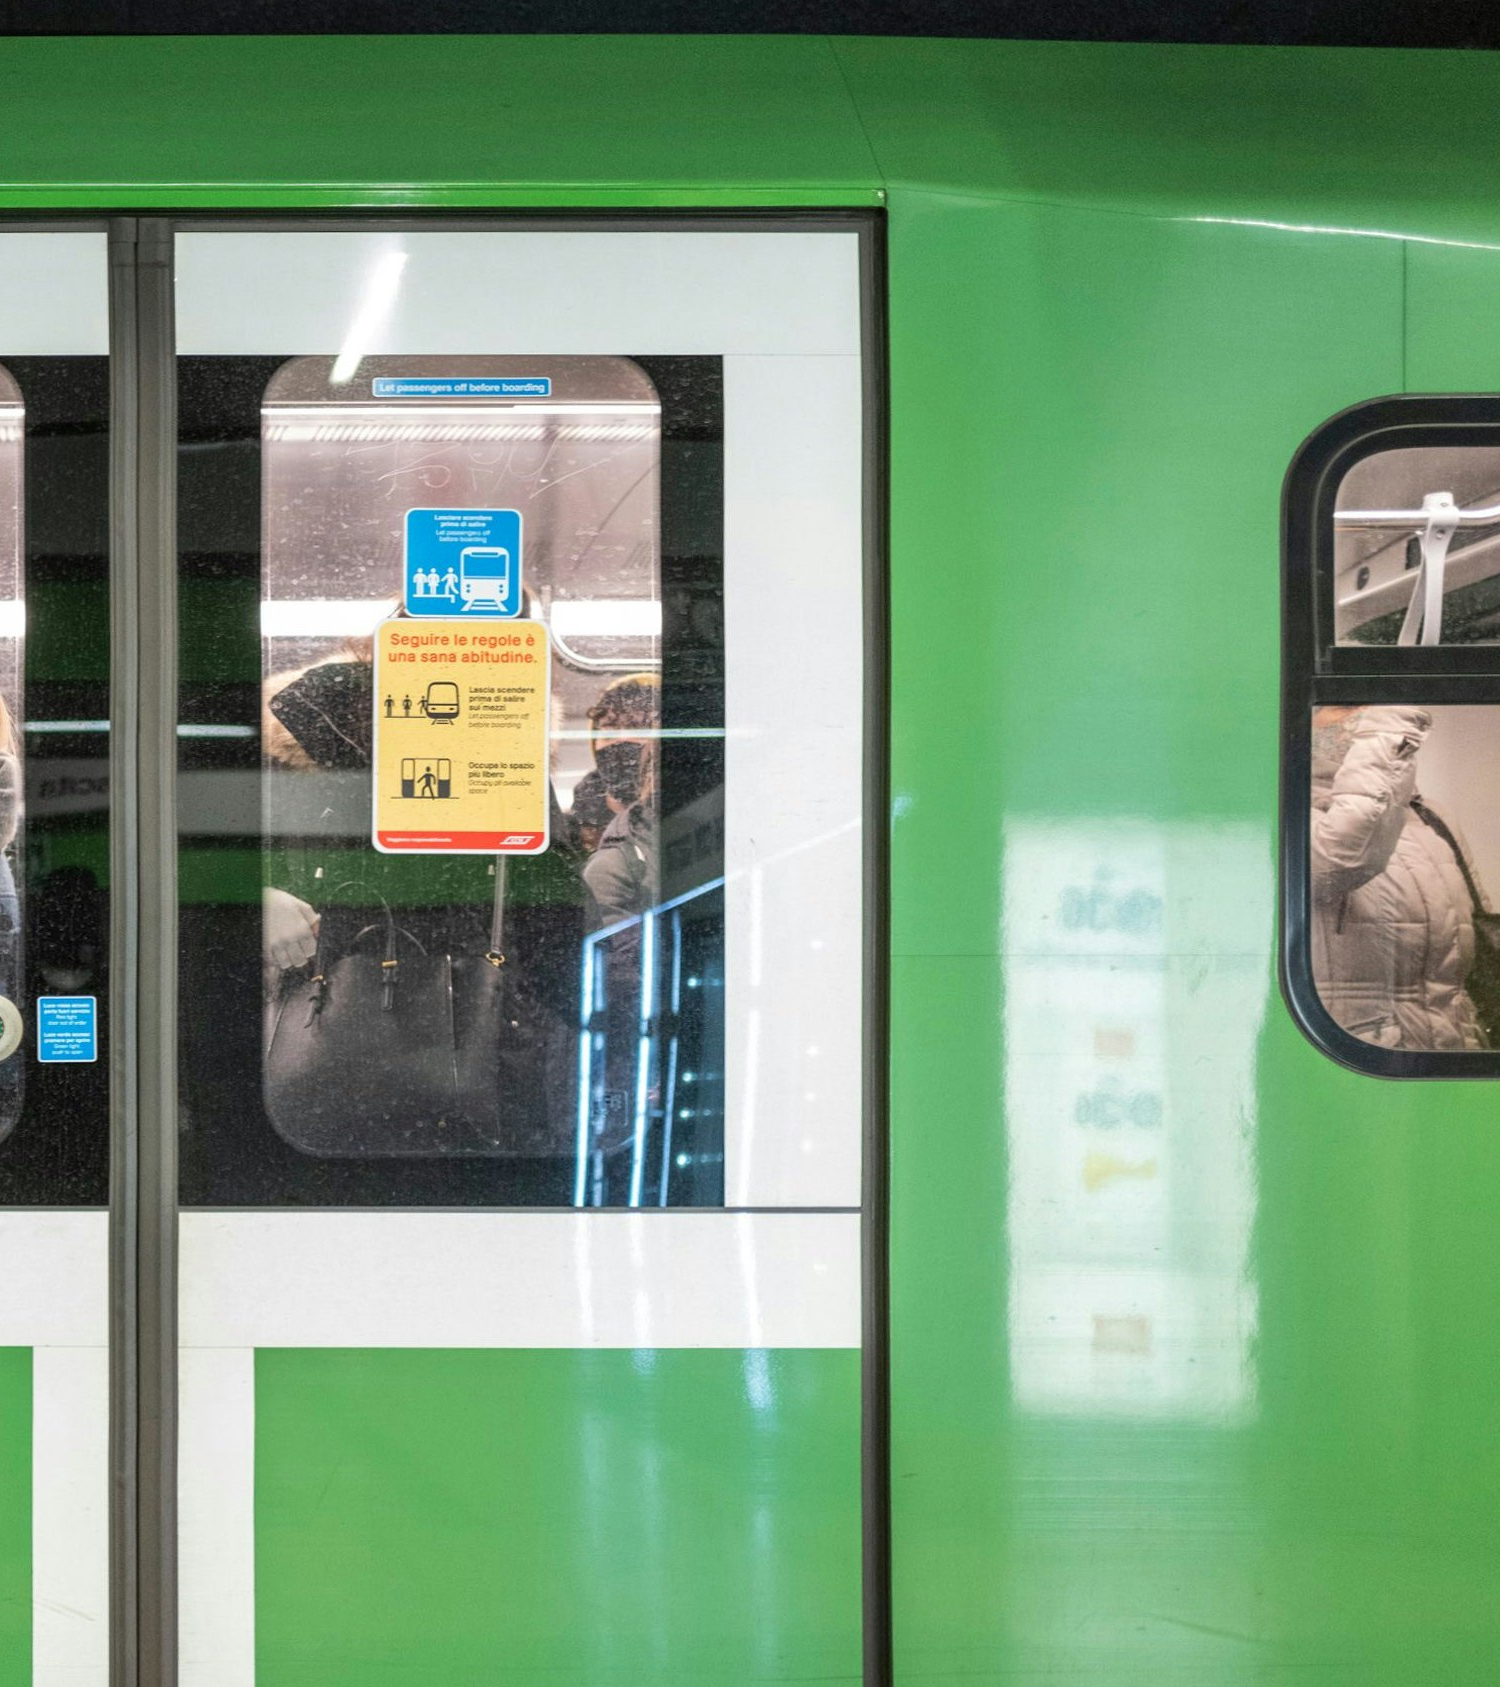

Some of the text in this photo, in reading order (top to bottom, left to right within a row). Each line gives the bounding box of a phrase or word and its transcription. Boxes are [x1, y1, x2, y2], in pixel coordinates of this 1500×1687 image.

[379, 383, 545, 394] Let passengers off before boarding
[390, 633, 535, 648] Seguire le regole è
[388, 651, 538, 663] una sana abitudine.
